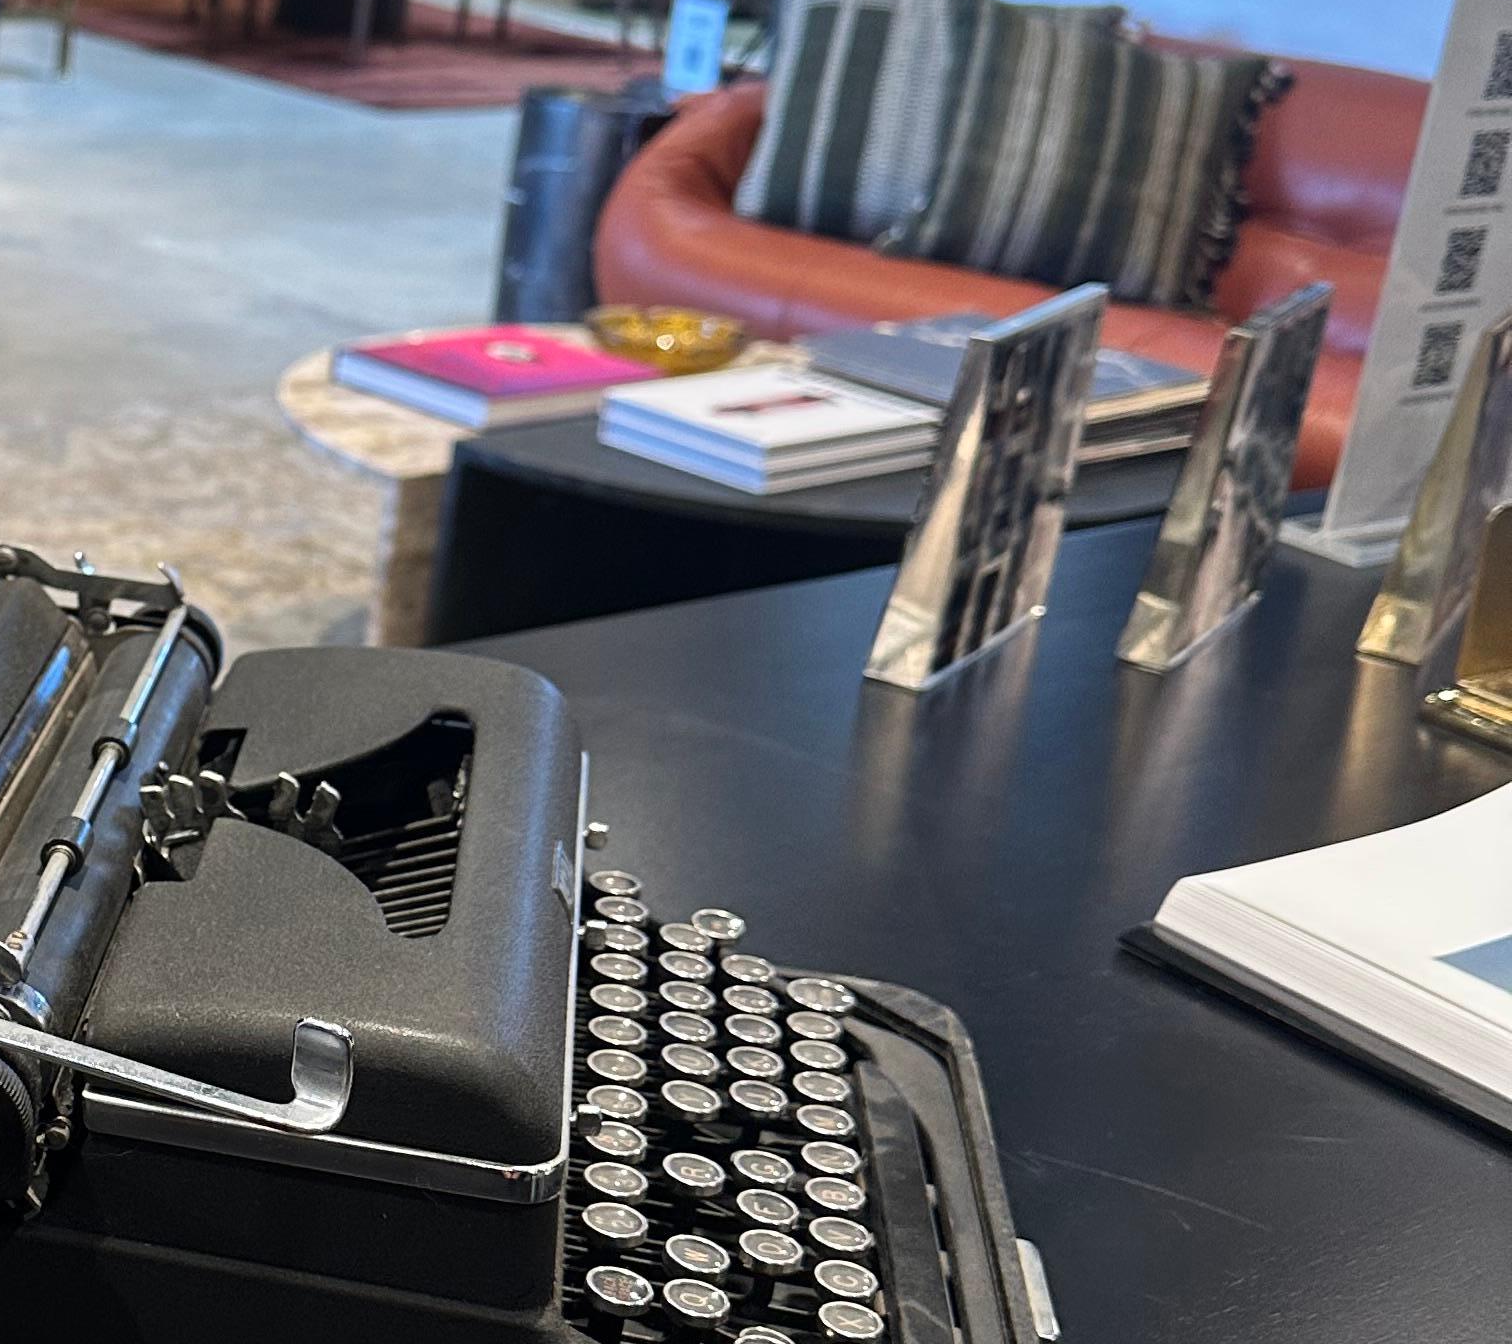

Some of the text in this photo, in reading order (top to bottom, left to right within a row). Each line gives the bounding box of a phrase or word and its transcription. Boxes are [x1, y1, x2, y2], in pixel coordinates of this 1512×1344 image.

[746, 1092, 770, 1104] J
[680, 1165, 706, 1179] R
[750, 1163, 776, 1176] G
[821, 1189, 849, 1202] B
[754, 1201, 779, 1216] F
[610, 1217, 637, 1229] 2
[826, 1227, 854, 1240] V
[683, 1247, 710, 1263] W
[832, 1274, 859, 1288] C
[679, 1292, 709, 1307] Q
[837, 1314, 865, 1330] X
